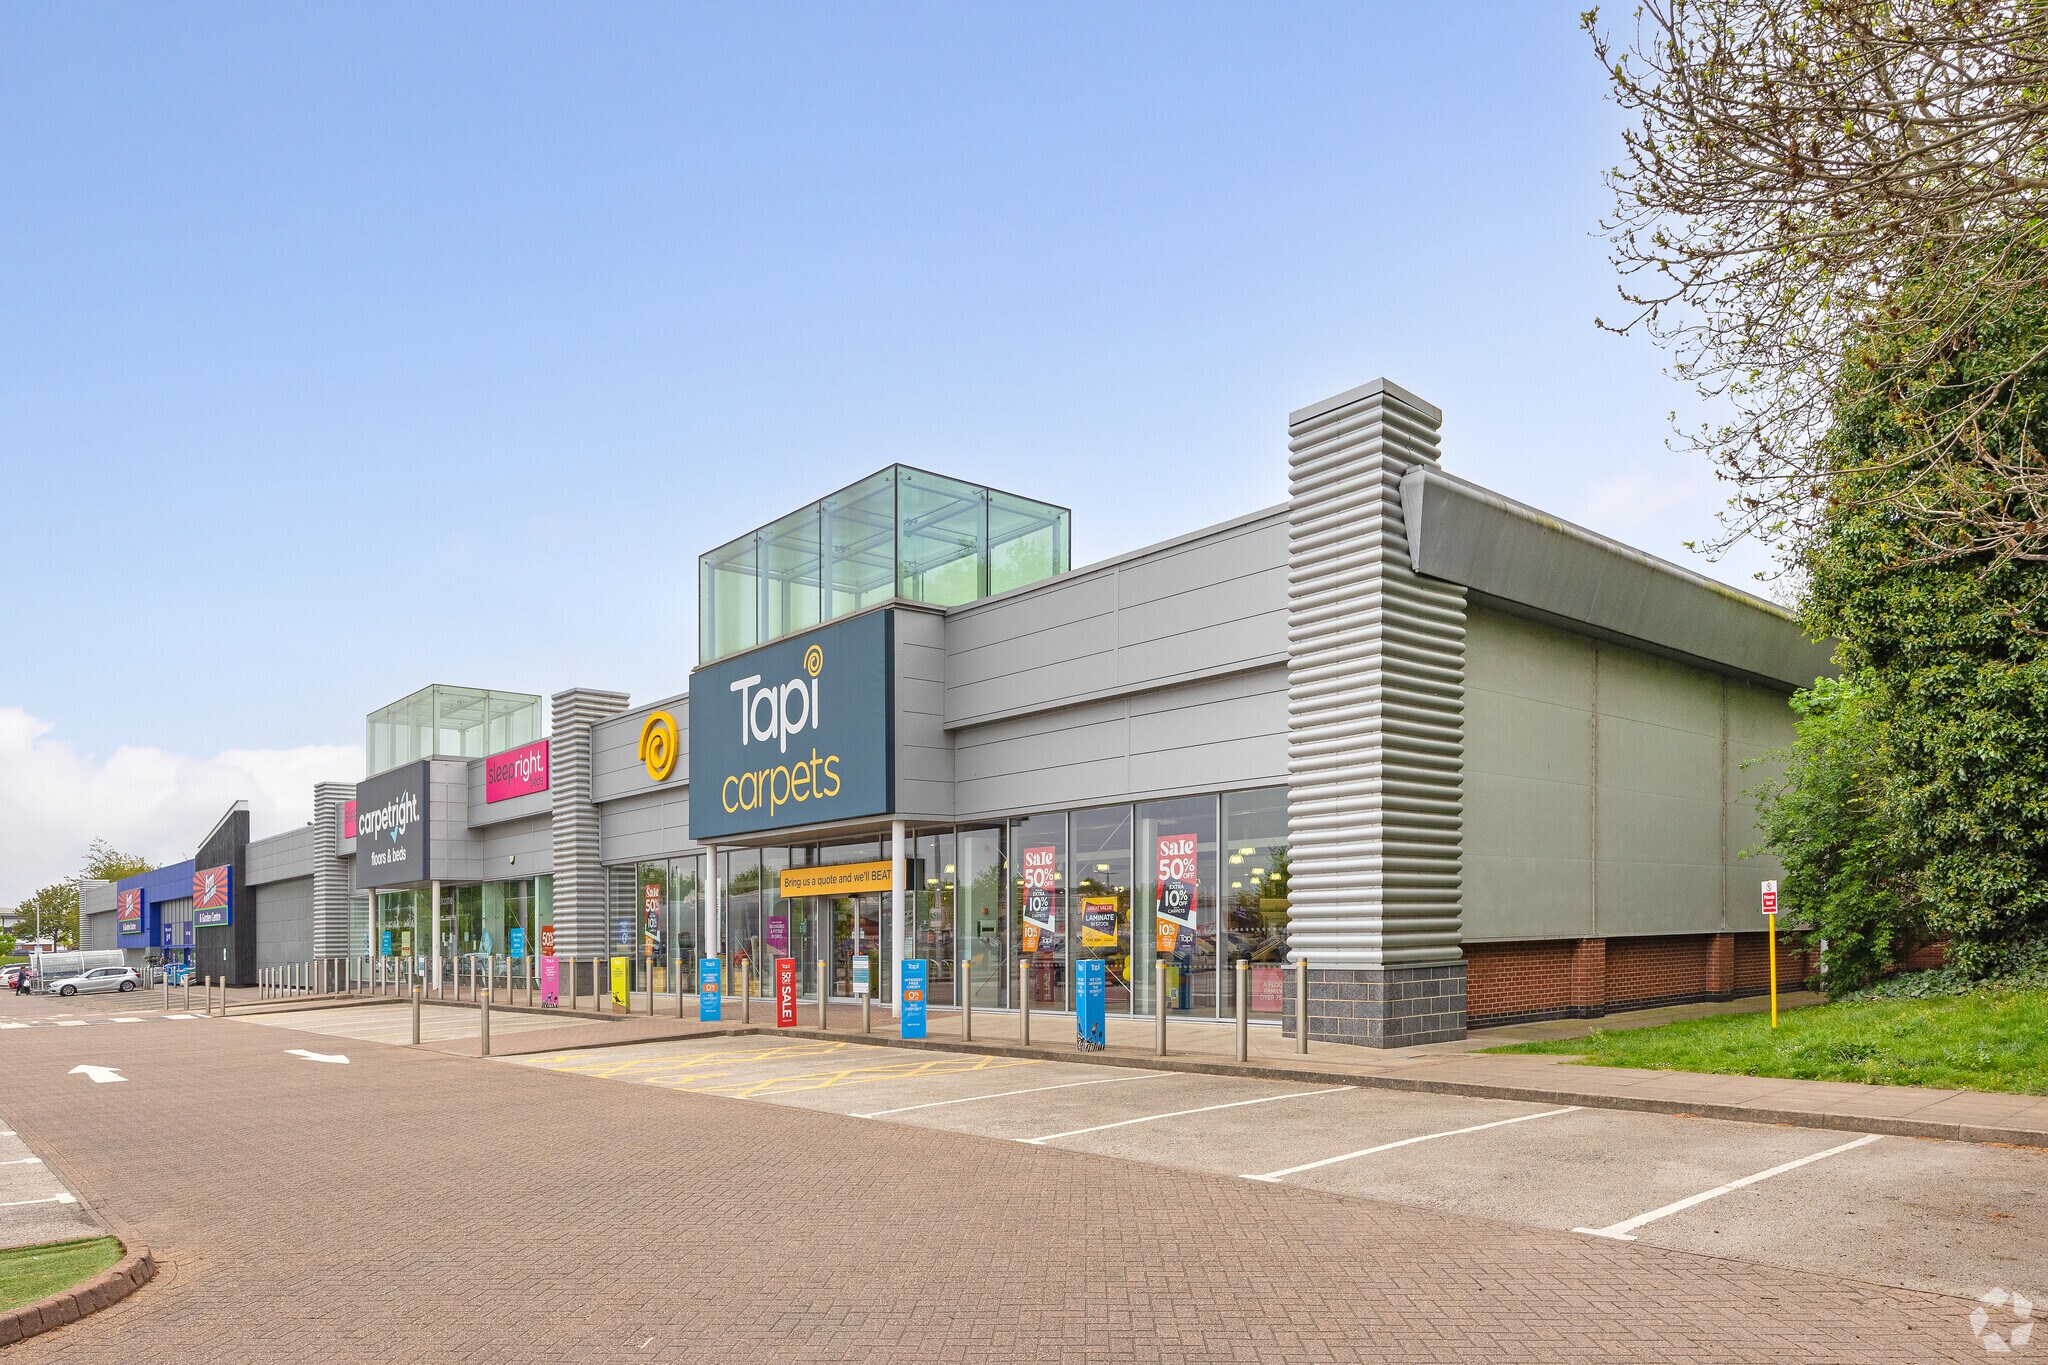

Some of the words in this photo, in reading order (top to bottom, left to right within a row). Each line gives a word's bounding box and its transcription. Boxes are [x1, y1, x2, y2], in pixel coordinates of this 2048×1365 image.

[730, 644, 824, 754] Tapi
[529, 776, 543, 787] beds
[722, 747, 841, 817] carpets
[371, 851, 387, 866] floors
[387, 849, 393, 862] &
[393, 846, 407, 861] beds
[1160, 840, 1194, 857] Sale
[1026, 852, 1053, 866] Sale
[1159, 858, 1195, 880] 50%
[784, 877, 801, 889] Bring
[803, 878, 811, 887] us
[812, 878, 817, 886] a
[818, 874, 838, 887] quote
[839, 872, 852, 884] and
[854, 870, 870, 881] we'll
[872, 869, 892, 881] BEAT
[1025, 868, 1053, 888] 50%
[646, 887, 659, 898] Sale
[1165, 890, 1188, 907] 10%
[440, 896, 454, 905] elcome
[646, 898, 660, 912] 50%
[1030, 897, 1048, 912] 10%
[1085, 913, 1115, 922] LAMINATE
[1159, 924, 1176, 936] 10%
[1180, 932, 1194, 944] Tapi
[782, 986, 792, 1018] SALE
[908, 991, 920, 999] 0%
